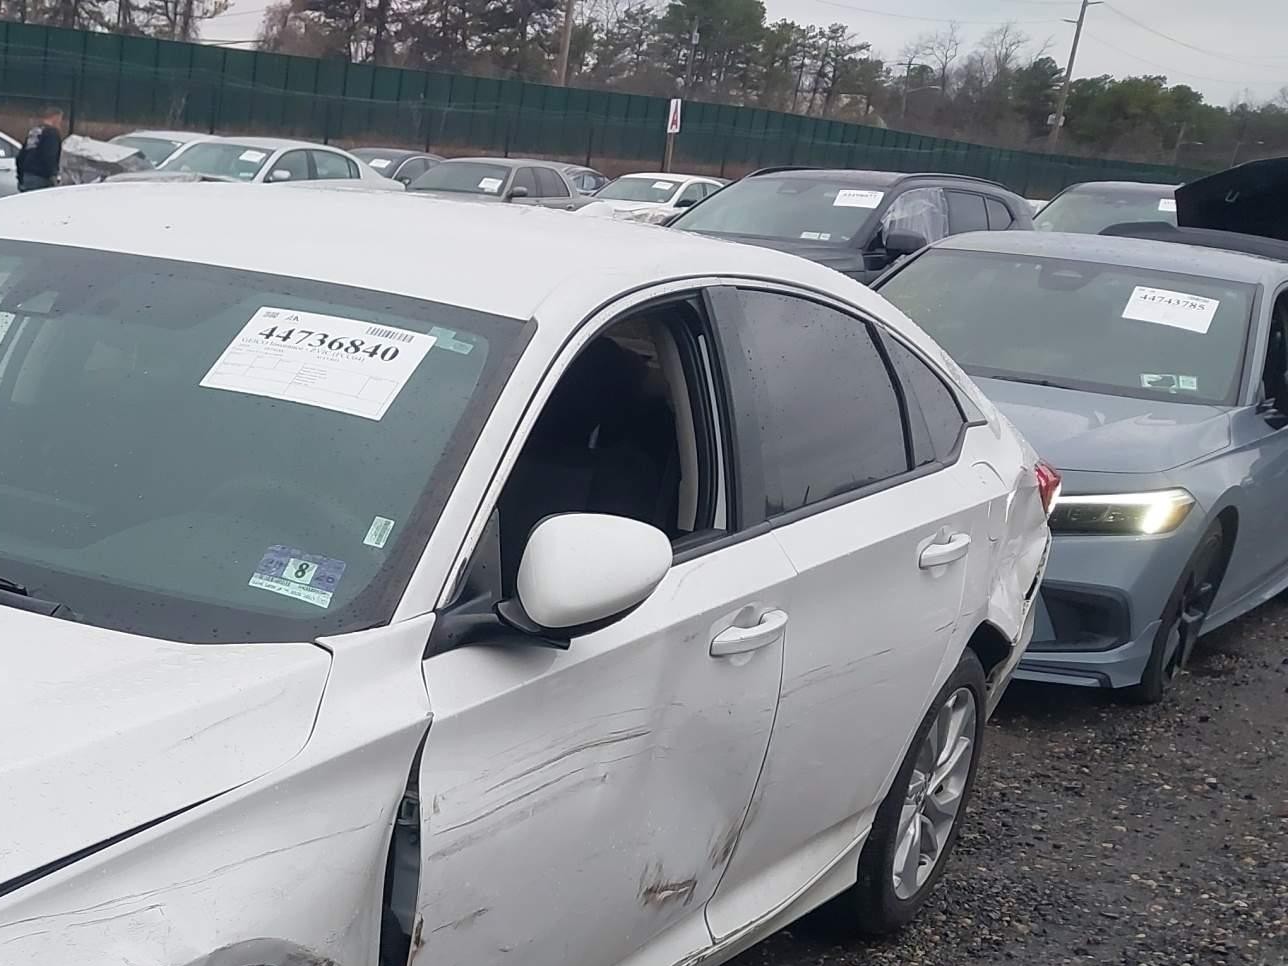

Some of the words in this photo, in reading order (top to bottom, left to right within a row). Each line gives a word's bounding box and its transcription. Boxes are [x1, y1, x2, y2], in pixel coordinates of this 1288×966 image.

[1139, 293, 1207, 311] 44743785
[258, 324, 400, 362] 44736840
[294, 562, 310, 579] 8
